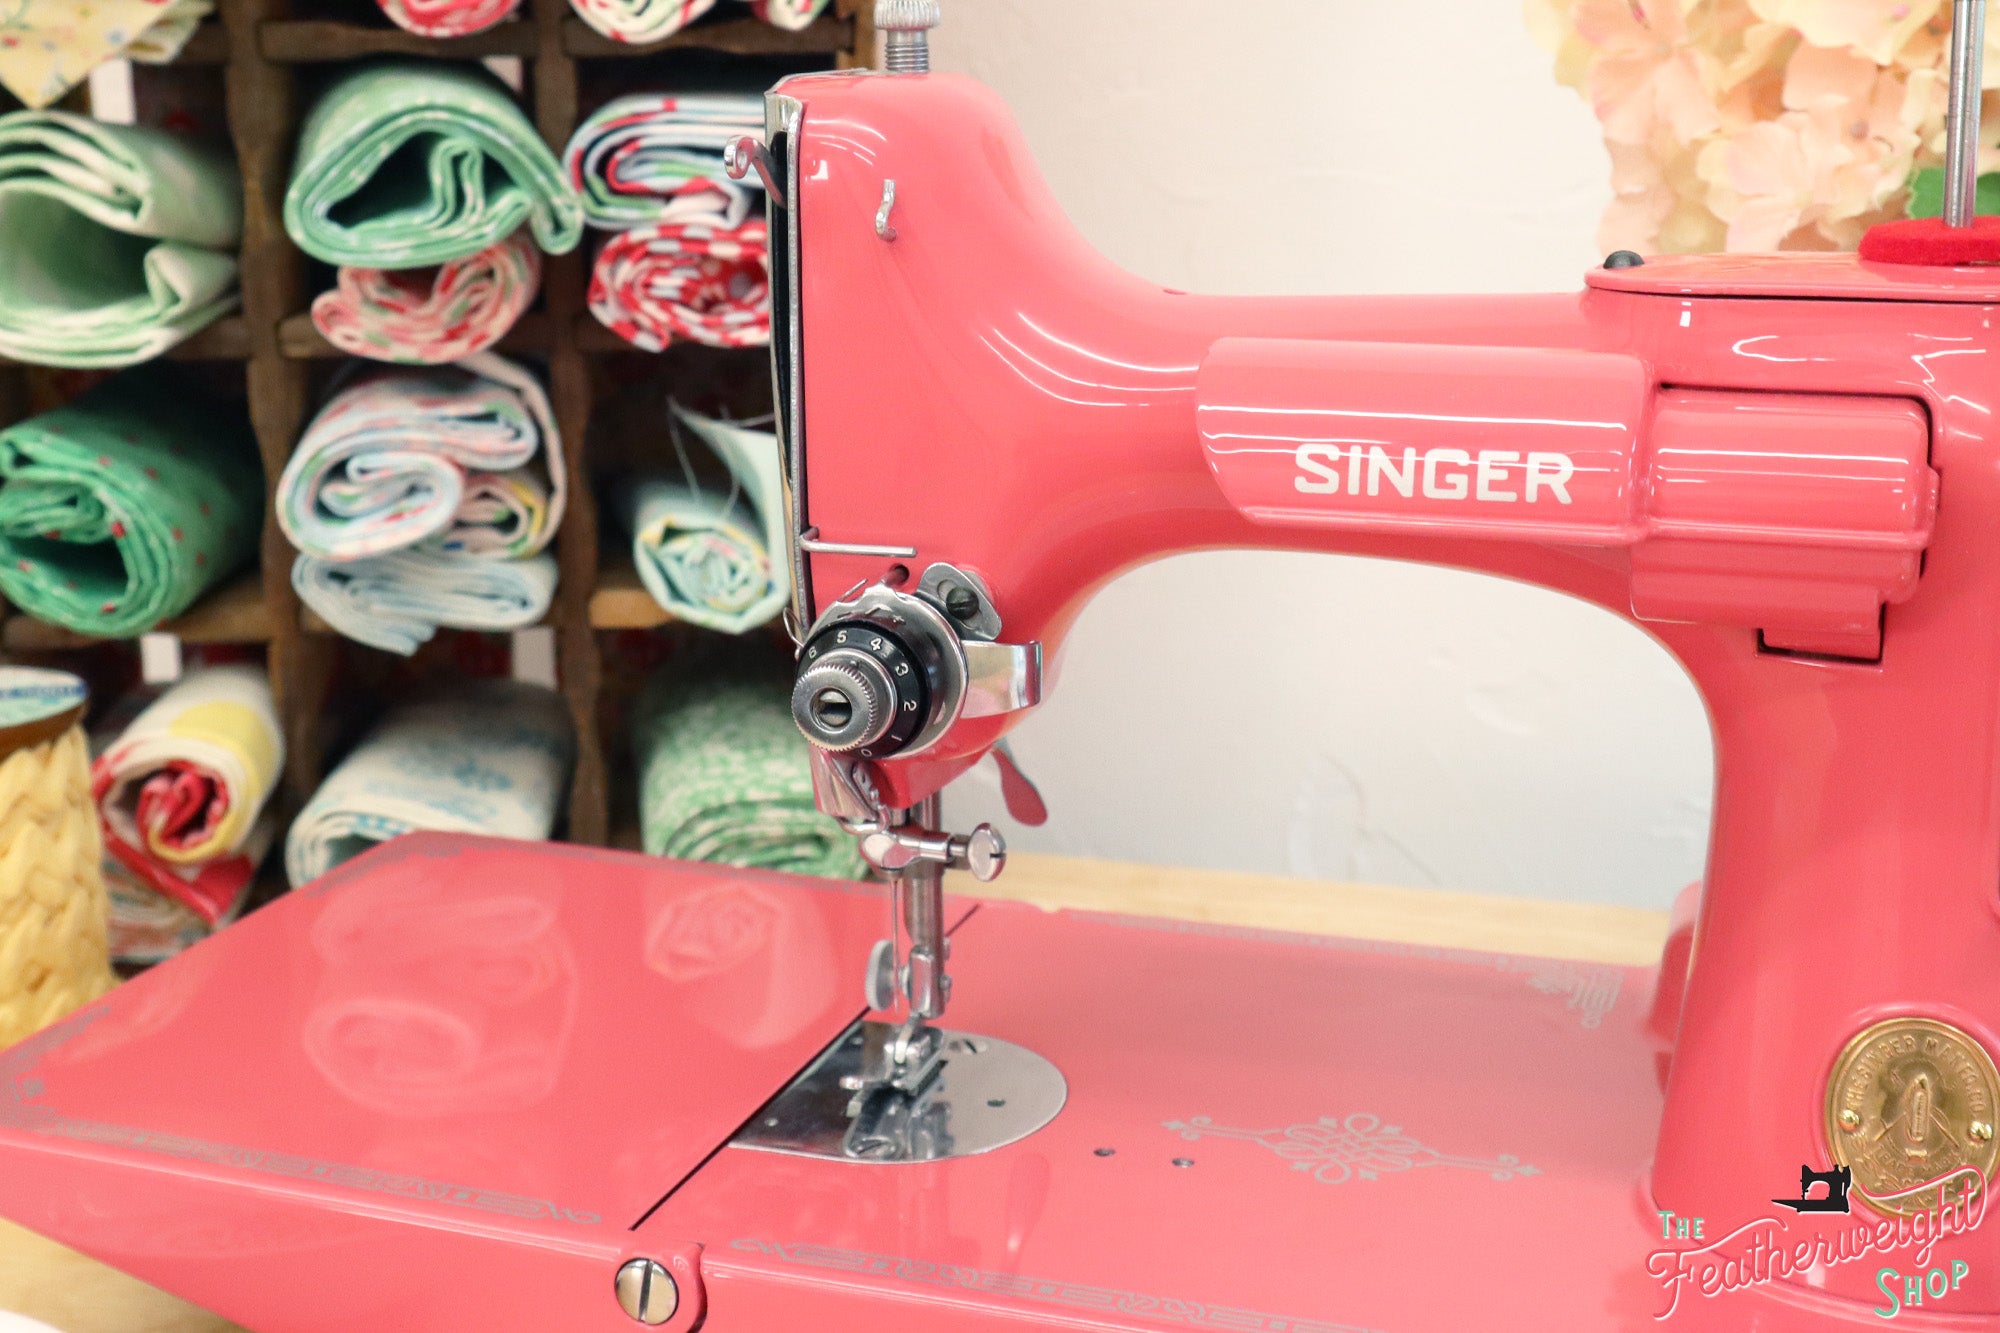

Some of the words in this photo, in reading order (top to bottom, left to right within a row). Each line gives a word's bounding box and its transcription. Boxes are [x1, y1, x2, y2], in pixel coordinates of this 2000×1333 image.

[1295, 443, 1574, 505] SINGER
[836, 630, 848, 644] 5
[870, 637, 882, 651] 4
[808, 646, 817, 659] 6
[895, 662, 909, 677] 3
[903, 699, 917, 712] 2
[860, 748, 873, 758] 0
